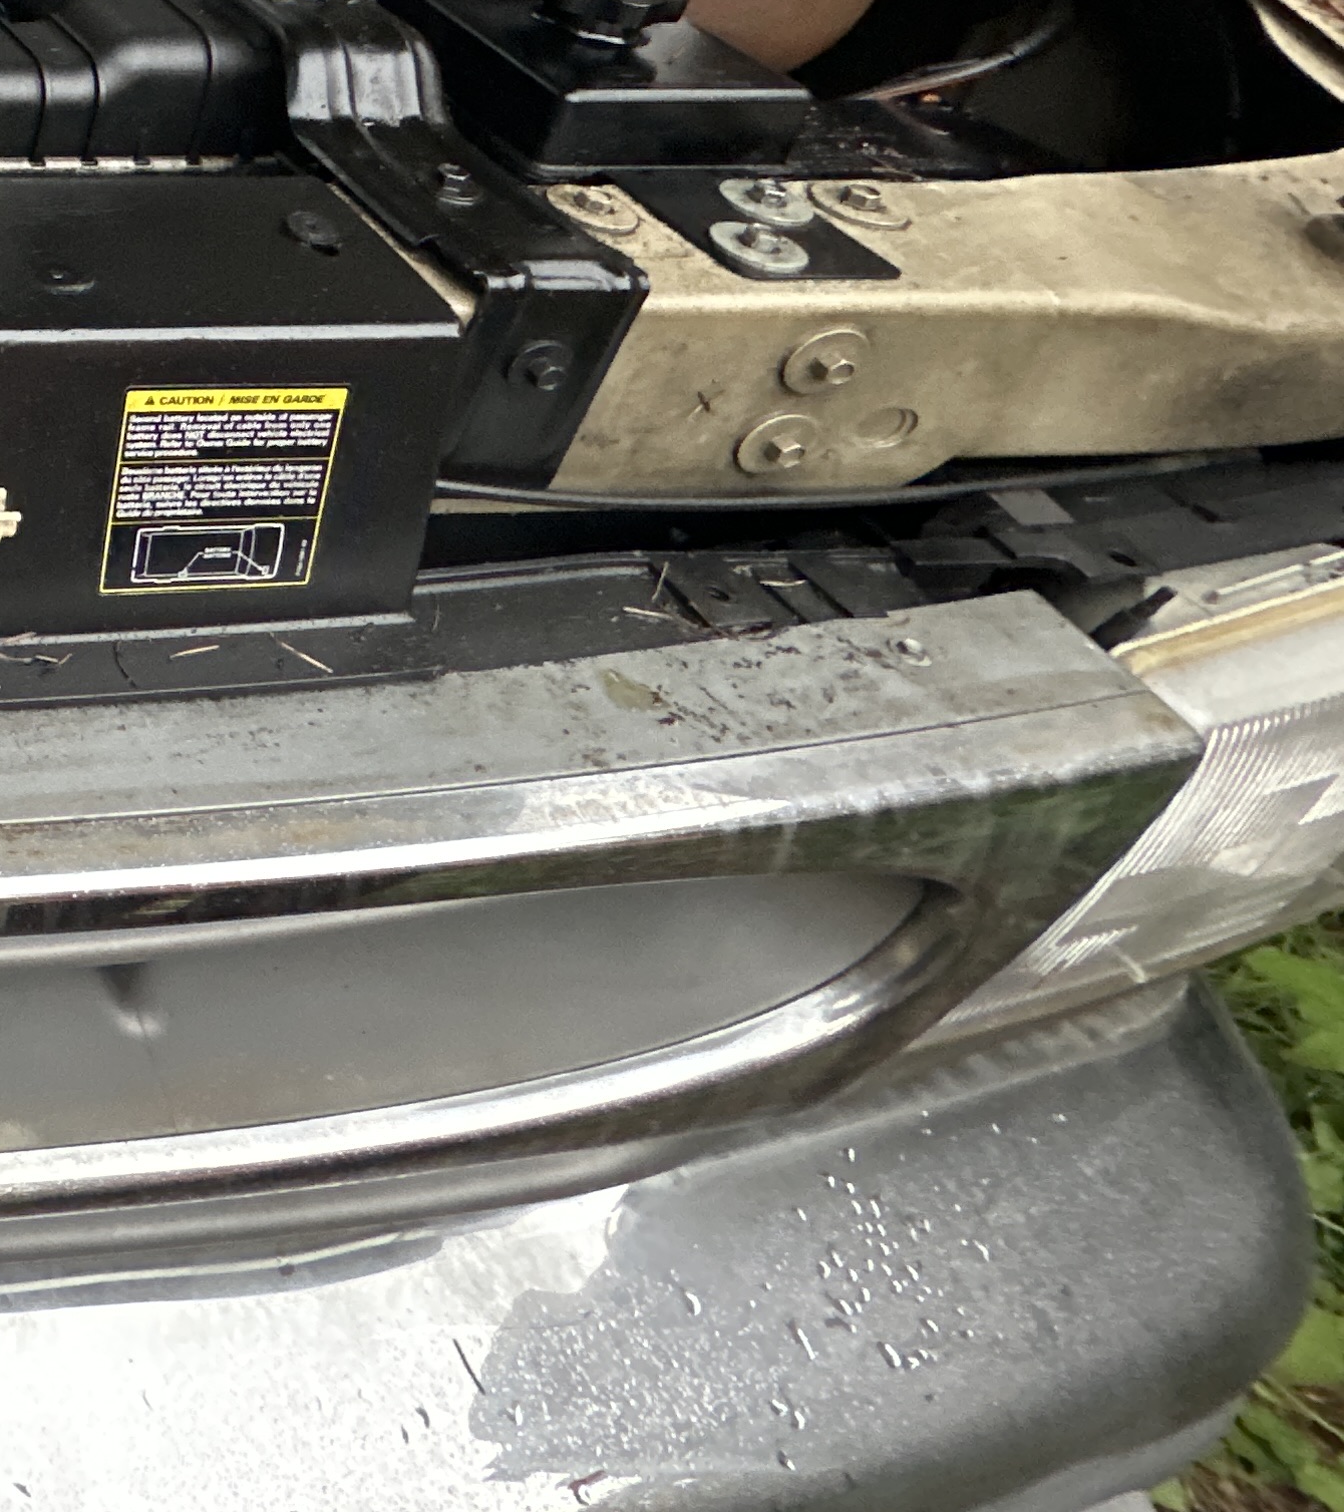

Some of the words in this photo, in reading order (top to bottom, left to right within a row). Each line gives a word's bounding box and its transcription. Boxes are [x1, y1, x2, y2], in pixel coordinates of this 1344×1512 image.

[159, 395, 214, 406] CAUTION
[229, 395, 260, 404] MISE
[262, 395, 280, 404] EN
[282, 394, 326, 404] GARDE
[183, 431, 205, 439] NOT
